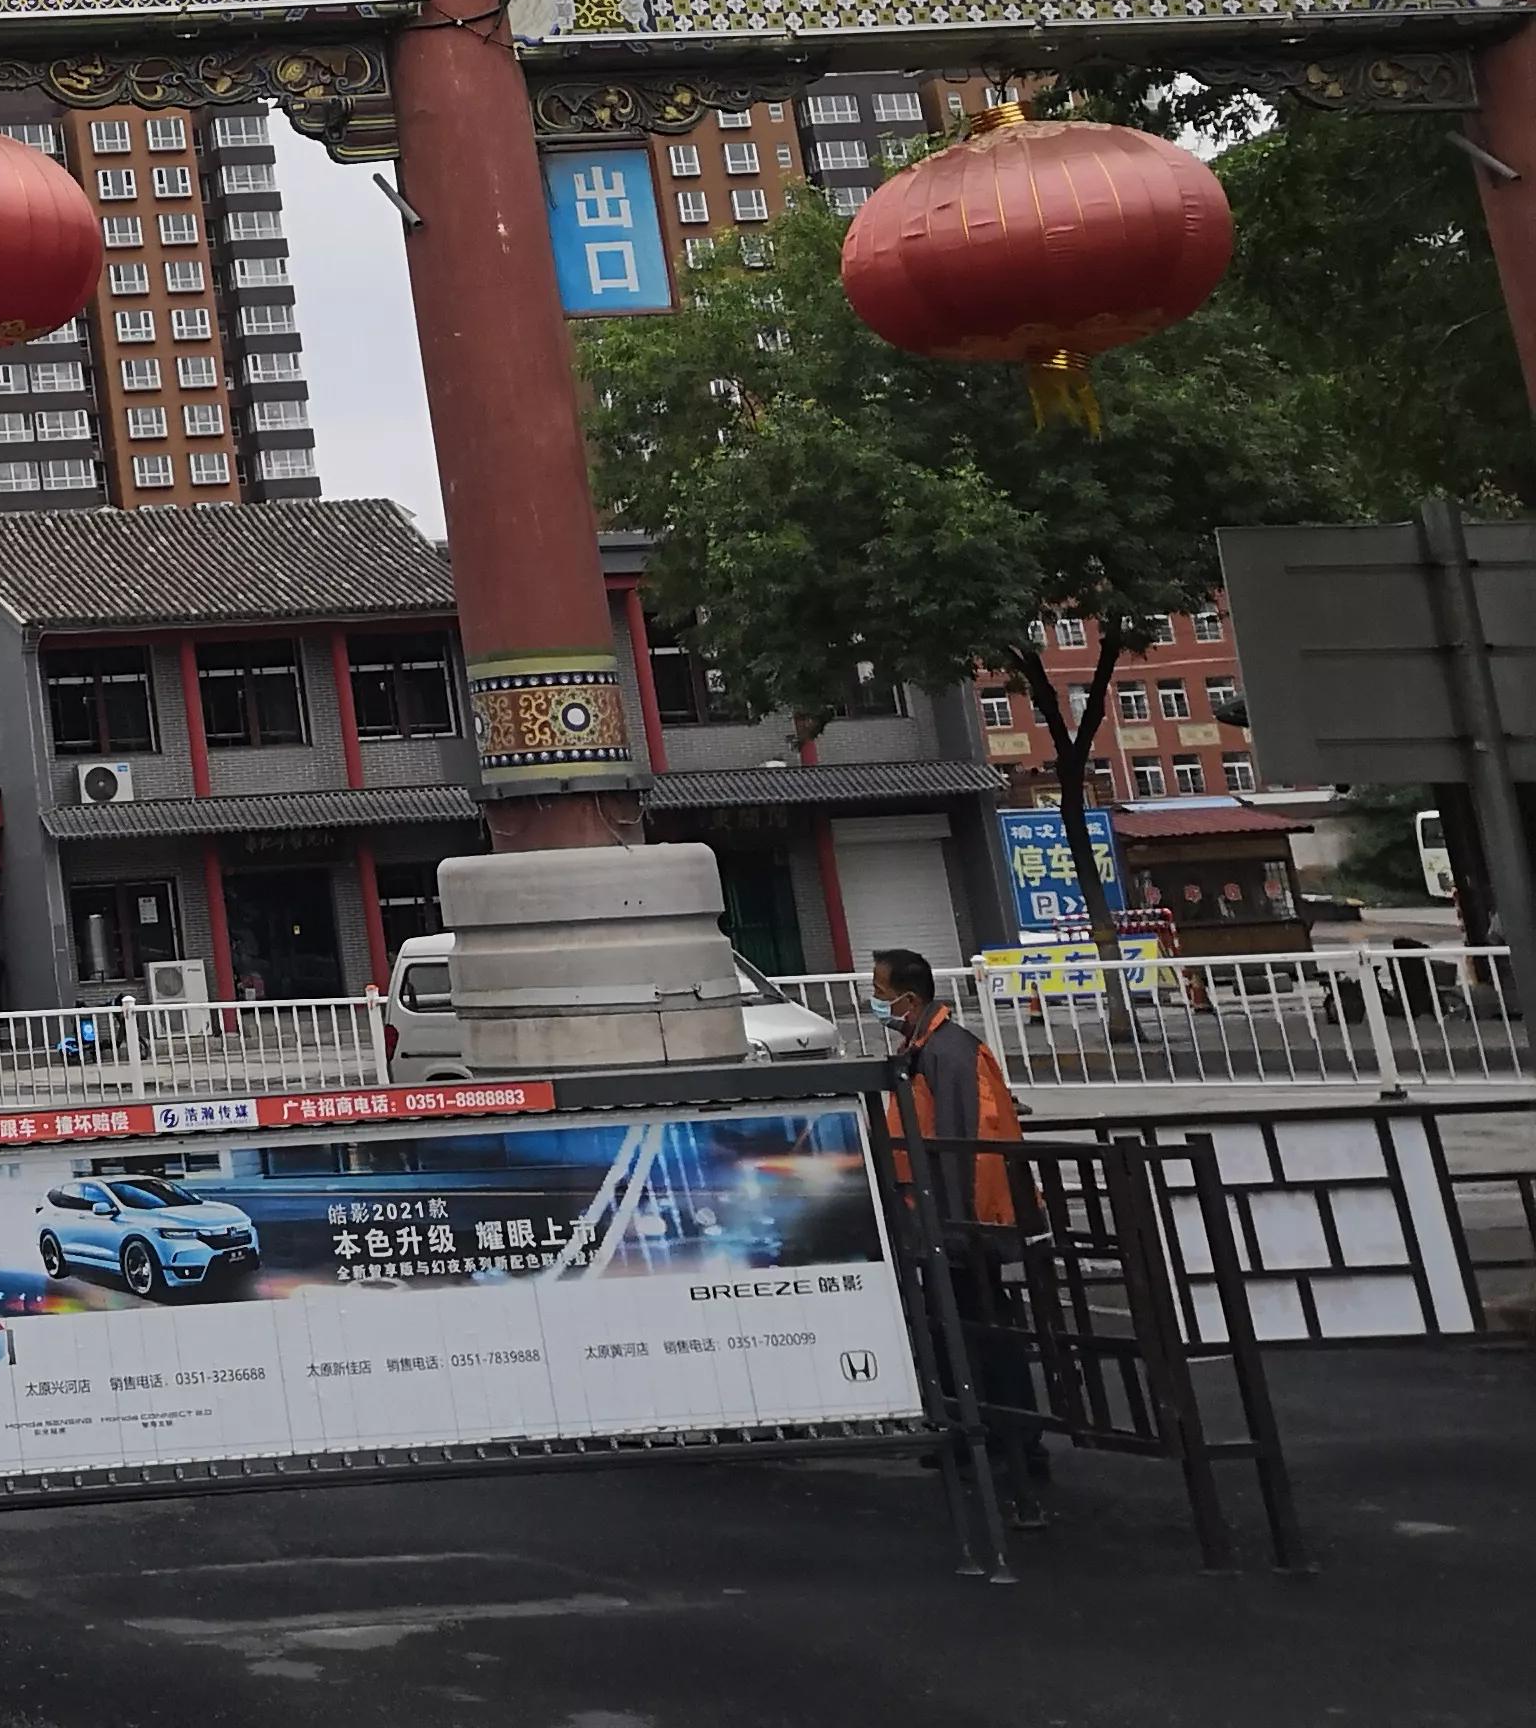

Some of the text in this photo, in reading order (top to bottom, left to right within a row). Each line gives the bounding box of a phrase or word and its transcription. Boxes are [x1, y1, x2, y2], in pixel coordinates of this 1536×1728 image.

[574, 167, 640, 294] 出口
[328, 1198, 448, 1225] 皓影2021款
[333, 1216, 597, 1260] 本色升级 耀眼上市
[690, 1275, 863, 1301] BREEZE 皓影
[584, 1342, 650, 1360] 太原黄河店
[25, 1377, 91, 1398] 太原兴河店
